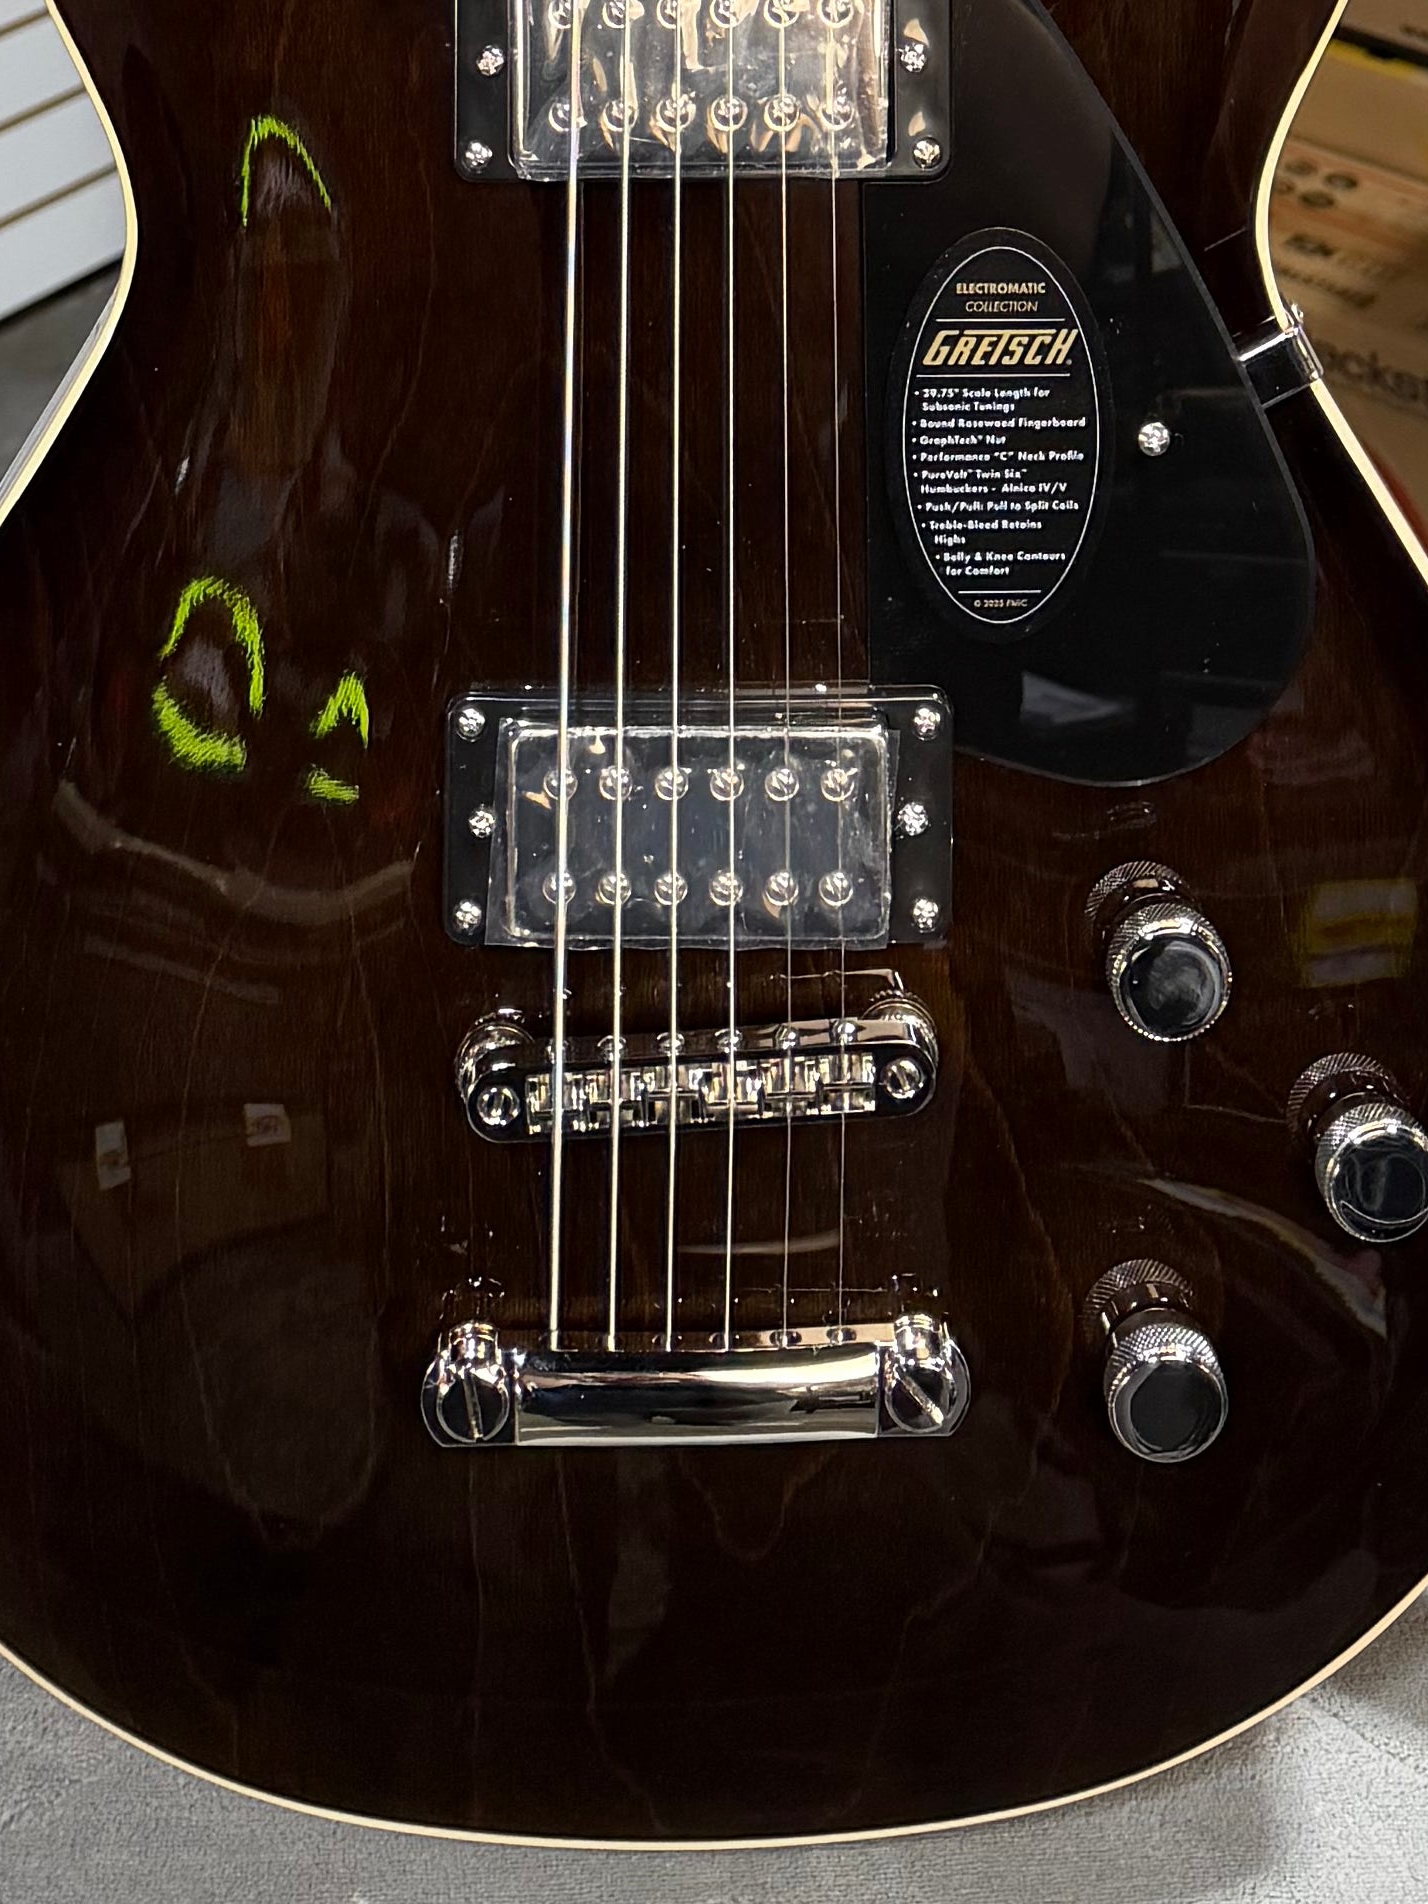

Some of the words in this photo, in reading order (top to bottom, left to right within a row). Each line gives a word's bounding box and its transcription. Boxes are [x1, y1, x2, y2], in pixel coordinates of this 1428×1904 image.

[956, 282, 1046, 294] ELECTROMATIC
[966, 301, 1038, 313] COLLECTION
[923, 329, 1078, 365] GRETSCH
[962, 388, 991, 398] Scale
[994, 387, 1031, 400] Length
[1034, 387, 1051, 397] for
[922, 401, 971, 411] Subsonic
[974, 402, 1015, 413] Tunings
[920, 418, 955, 428] Bound
[958, 418, 1015, 428] Rosewood
[1019, 417, 1086, 430] Fingerboard
[985, 435, 1006, 444] Nut
[920, 451, 990, 461] Performance
[1018, 451, 1045, 461] Neck
[1049, 450, 1084, 461] Profile
[976, 469, 1000, 479] Twin
[921, 483, 988, 494] Humbuckers
[1002, 483, 1035, 493] Alnico
[1039, 482, 1067, 494] IV/V
[1010, 502, 1021, 511] to
[1025, 500, 1049, 513] Split
[1052, 499, 1079, 510] Coils
[930, 520, 998, 530] Treble-Bleed
[1002, 519, 1042, 529] Retains
[934, 534, 966, 546] Highs
[943, 552, 971, 564] Belly
[974, 552, 983, 561] &
[986, 552, 1014, 561] Knee
[1017, 551, 1066, 561] Contours
[946, 566, 962, 576] for
[965, 565, 1010, 576] Comfort
